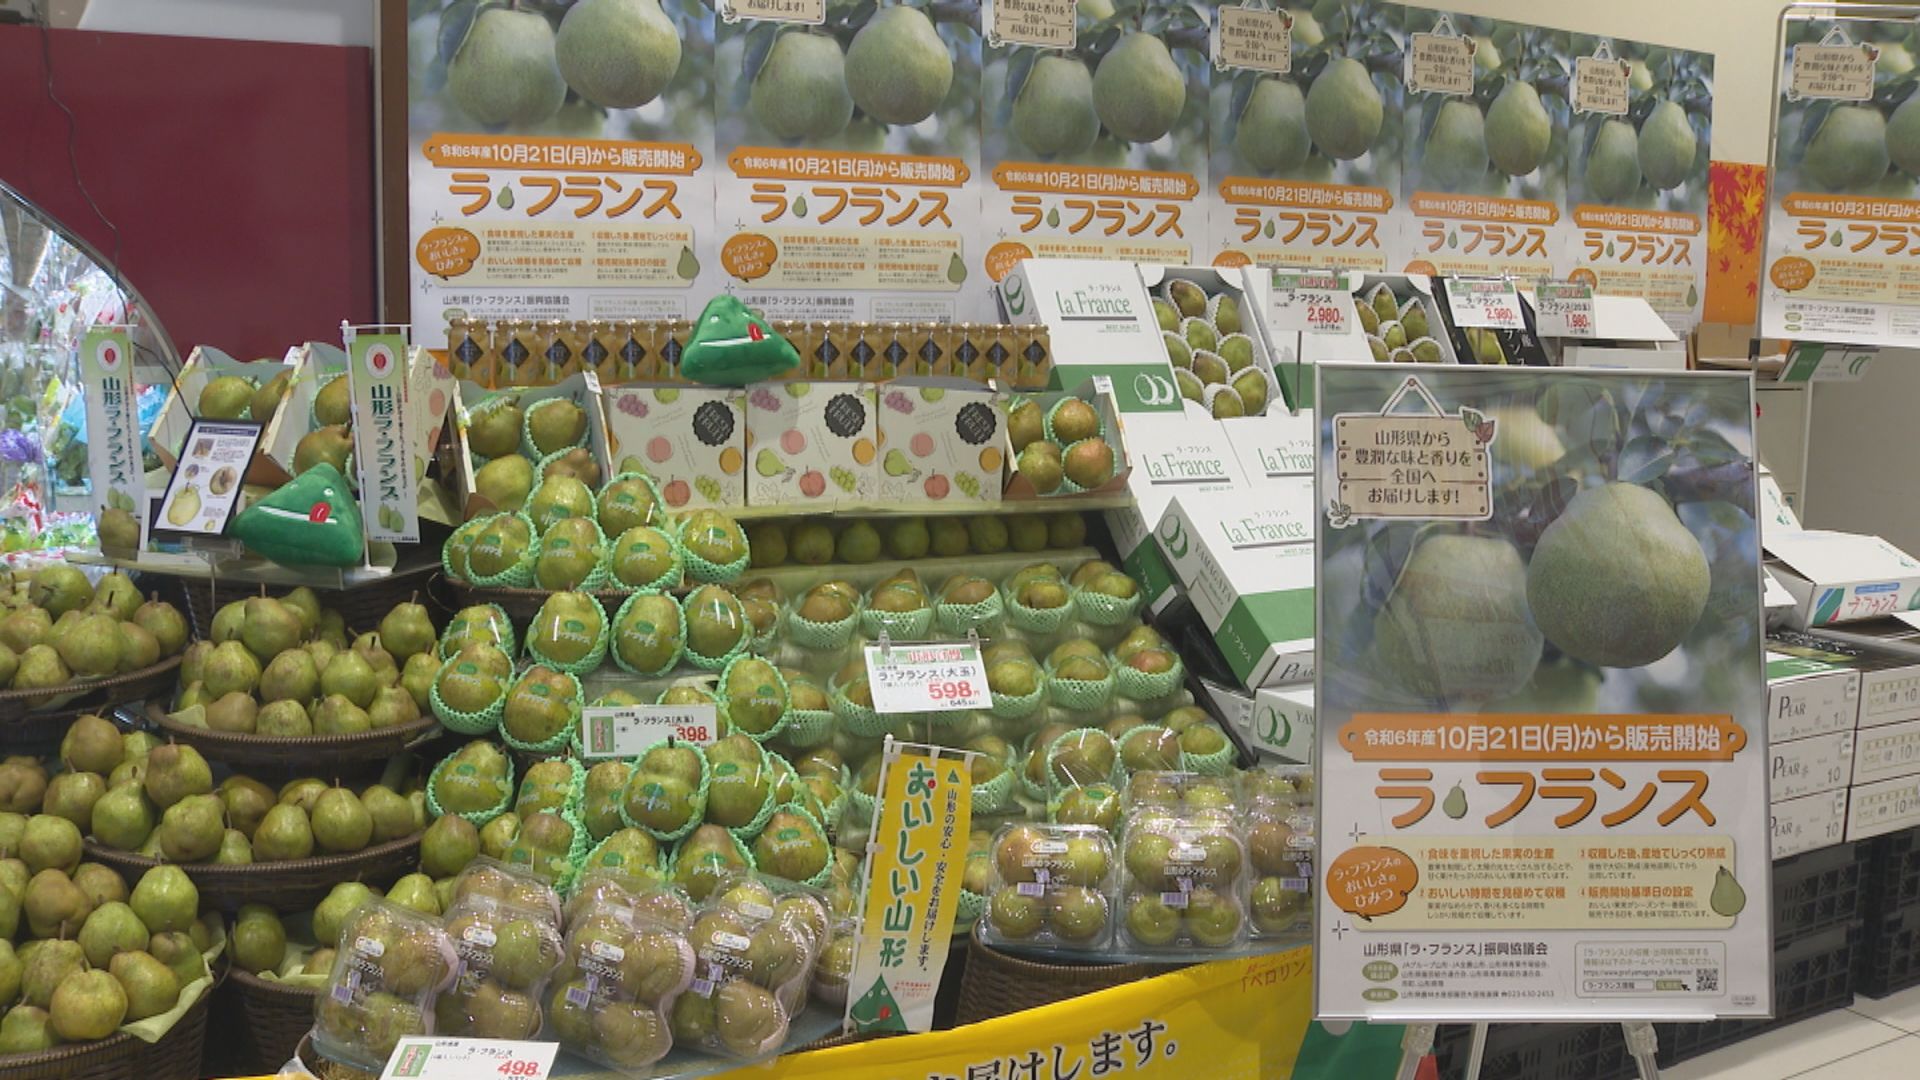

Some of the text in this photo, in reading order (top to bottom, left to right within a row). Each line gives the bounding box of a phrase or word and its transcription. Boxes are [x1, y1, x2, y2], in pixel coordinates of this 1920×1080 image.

[1307, 306, 1340, 323] 2,980
[1374, 431, 1451, 448] 山形県から
[1354, 449, 1472, 467] 豊潤な味と香りを
[1389, 468, 1437, 485] 全国へ
[1367, 489, 1460, 504] お届けします!
[878, 666, 977, 682] ラ・フランス(大玉)
[1364, 725, 1721, 752] 令和6年産10月21日(月)から販売開始
[879, 760, 937, 970] おいしい山形
[1333, 856, 1402, 881] ラ・フランスの
[1345, 873, 1397, 893] おいしさの
[1354, 889, 1395, 908] ひみつ
[1363, 942, 1549, 958] 山形県「ラ・フランス」振興協議会
[929, 1021, 1177, 1080] 届けします。
[498, 1060, 539, 1077] 498
